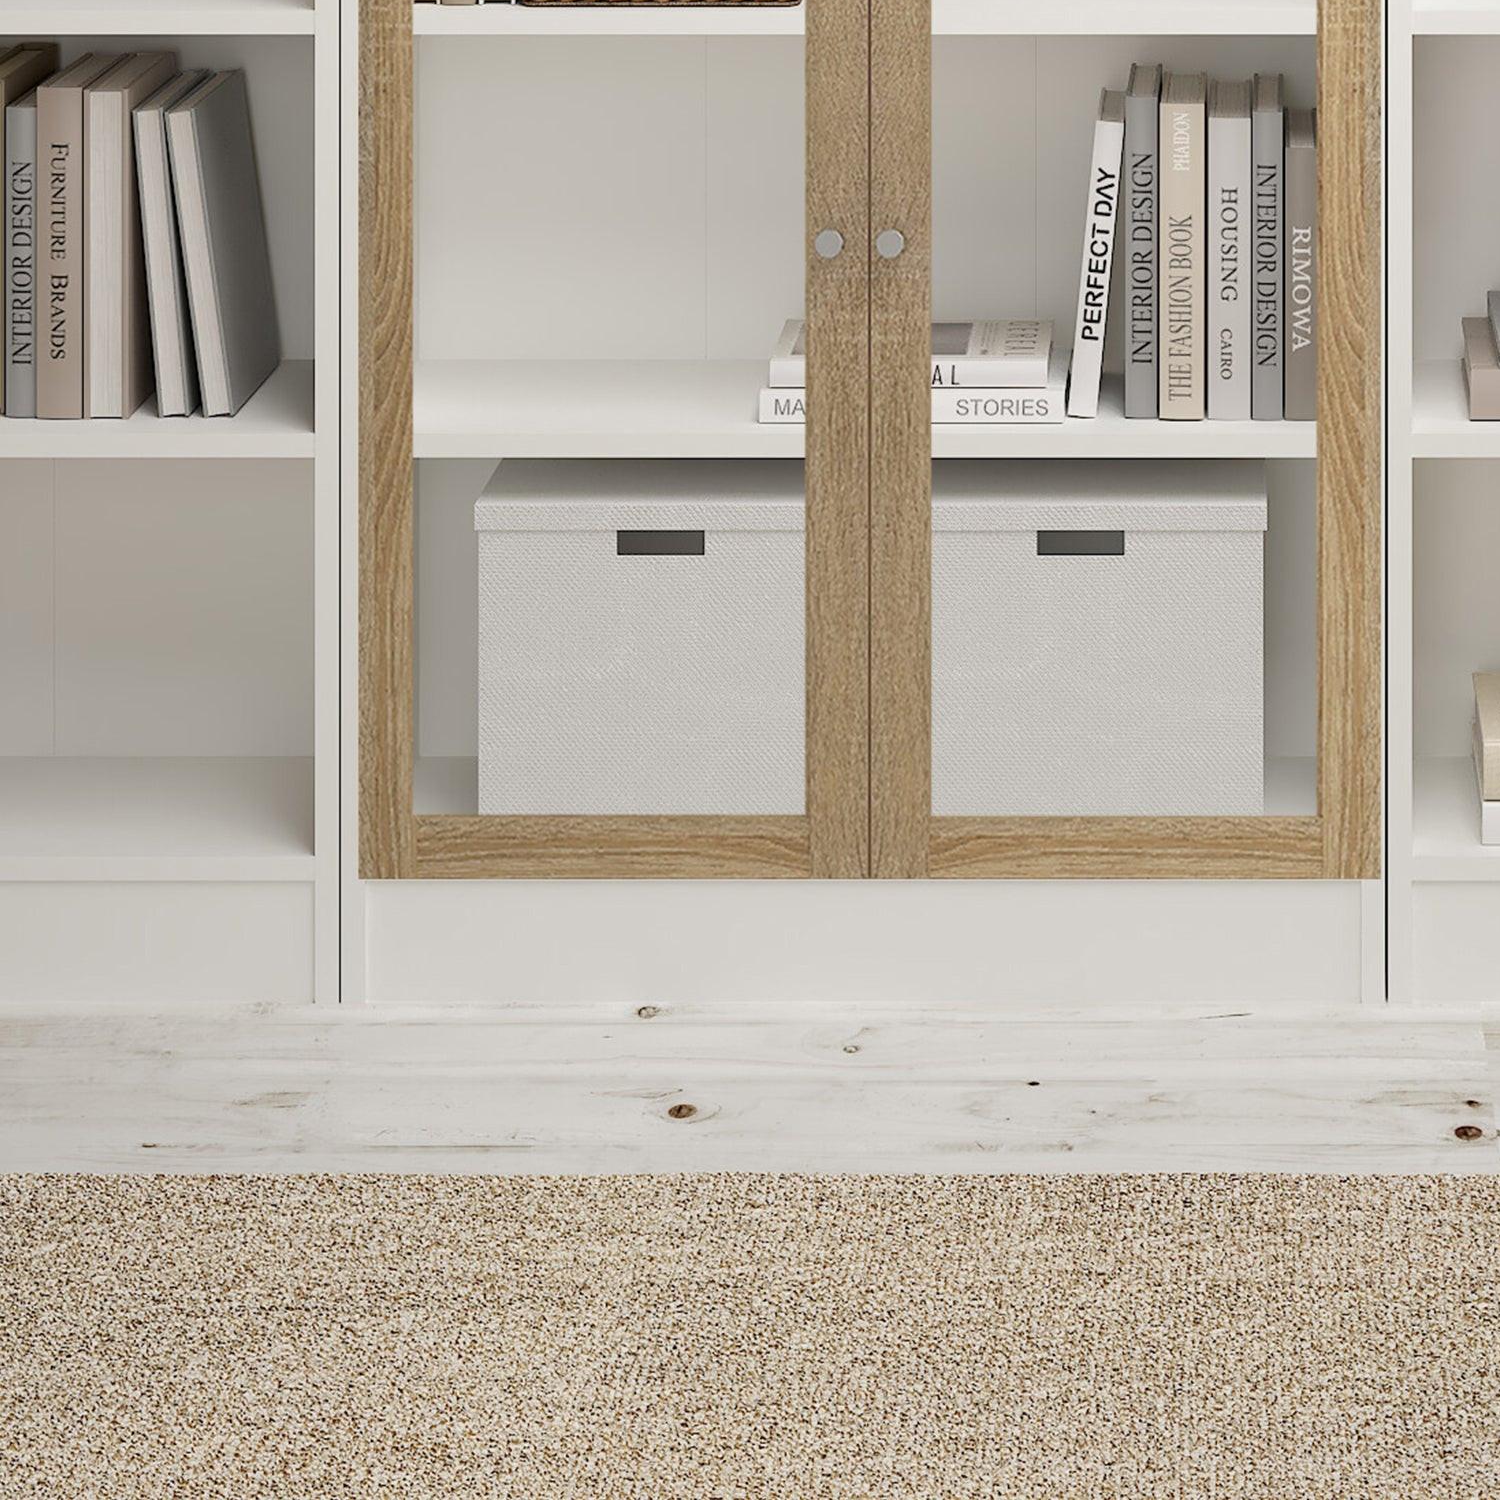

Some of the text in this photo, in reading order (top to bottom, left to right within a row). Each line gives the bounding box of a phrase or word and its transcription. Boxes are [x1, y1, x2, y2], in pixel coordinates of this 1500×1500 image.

[1173, 111, 1191, 172] PHAIDON
[11, 161, 33, 365] INTERIOR DESIGN
[50, 143, 69, 360] FURNITURE BRANDS
[1081, 167, 1116, 341] PERFECT DAY
[1131, 153, 1154, 364] INTERIOR DESIGN
[1168, 215, 1193, 402] THE FASHION BOOK
[1219, 187, 1239, 381] HOUSING CAIRO
[1256, 164, 1278, 367] INTERIOR DESIGN
[1291, 225, 1312, 352] RIMOWA
[955, 398, 1050, 417] STORIES
